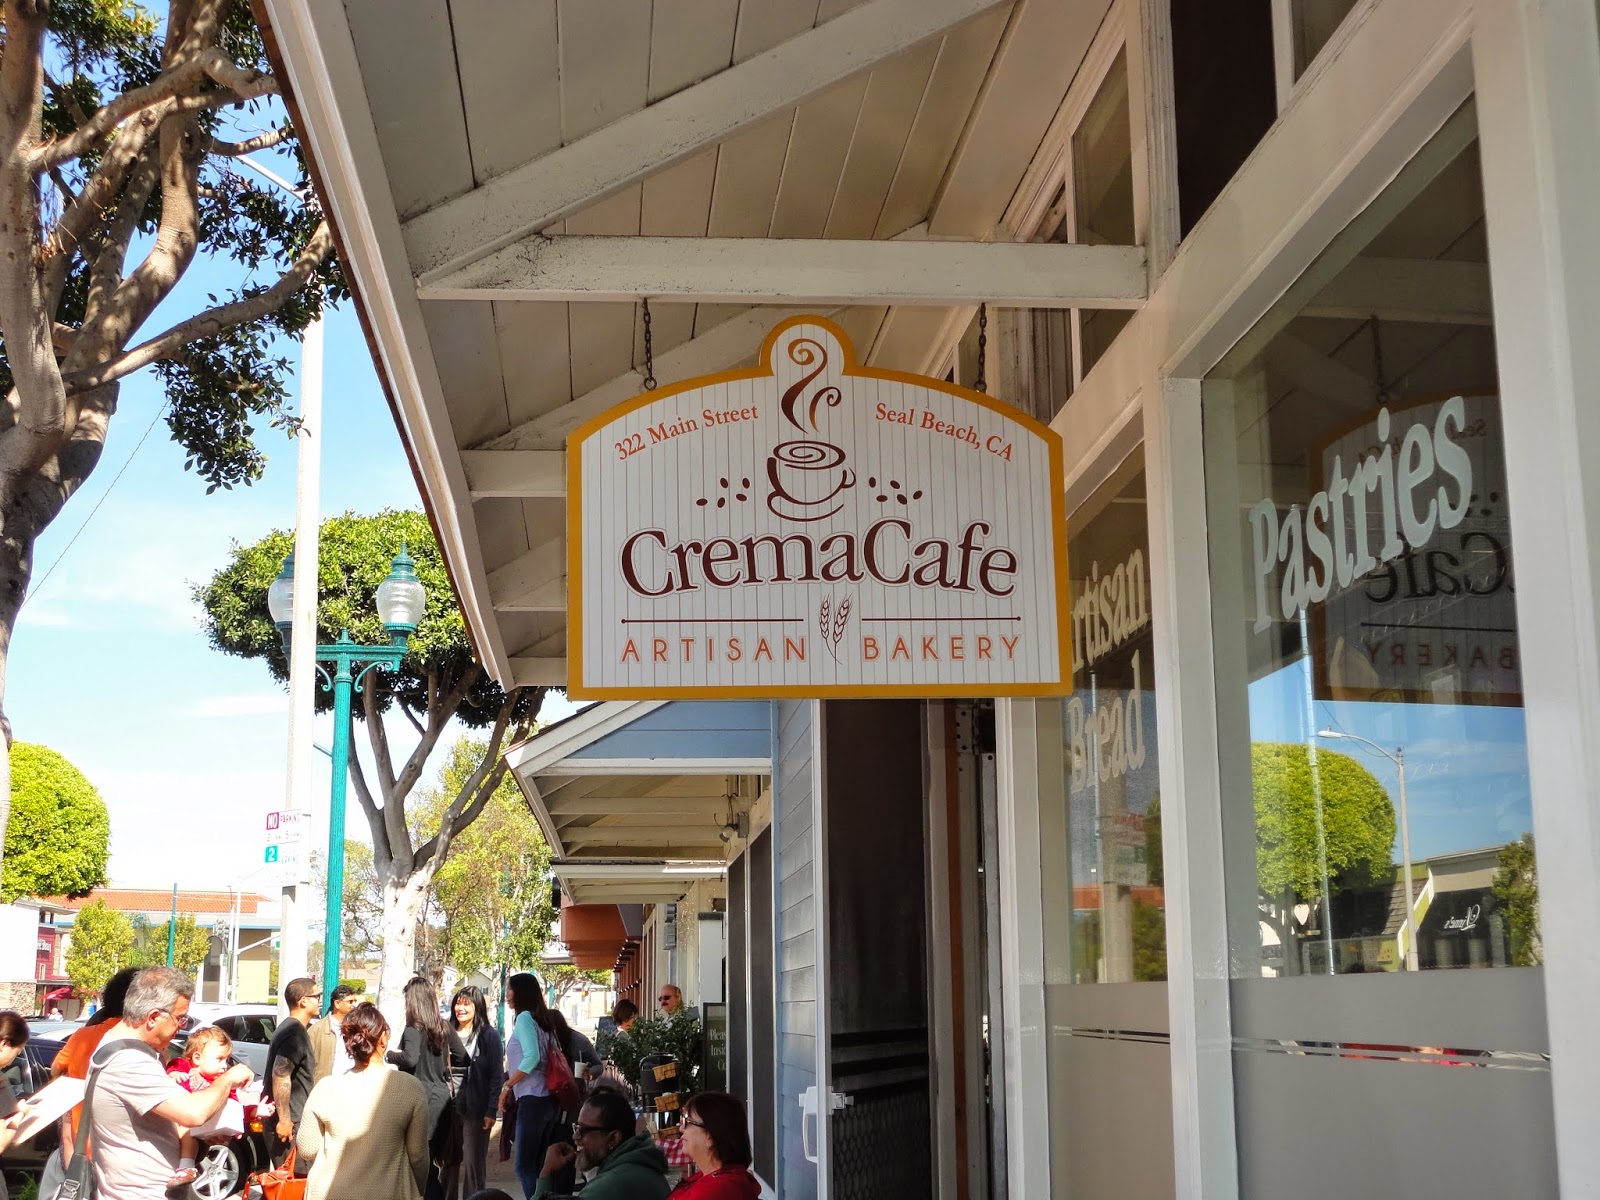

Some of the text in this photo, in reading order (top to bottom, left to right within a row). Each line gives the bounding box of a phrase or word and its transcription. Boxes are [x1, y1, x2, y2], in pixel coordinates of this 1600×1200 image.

[614, 405, 759, 460] 322 Main Street
[875, 402, 1013, 462] Seal Beach, CA
[1249, 395, 1473, 635] Pastries
[619, 517, 1019, 598] CremaCafe
[1072, 548, 1149, 674] rtisan
[620, 635, 1020, 662] ARTISAN BAKERY
[1067, 648, 1146, 795] Bread
[267, 814, 279, 829] NO
[268, 847, 276, 862] 2
